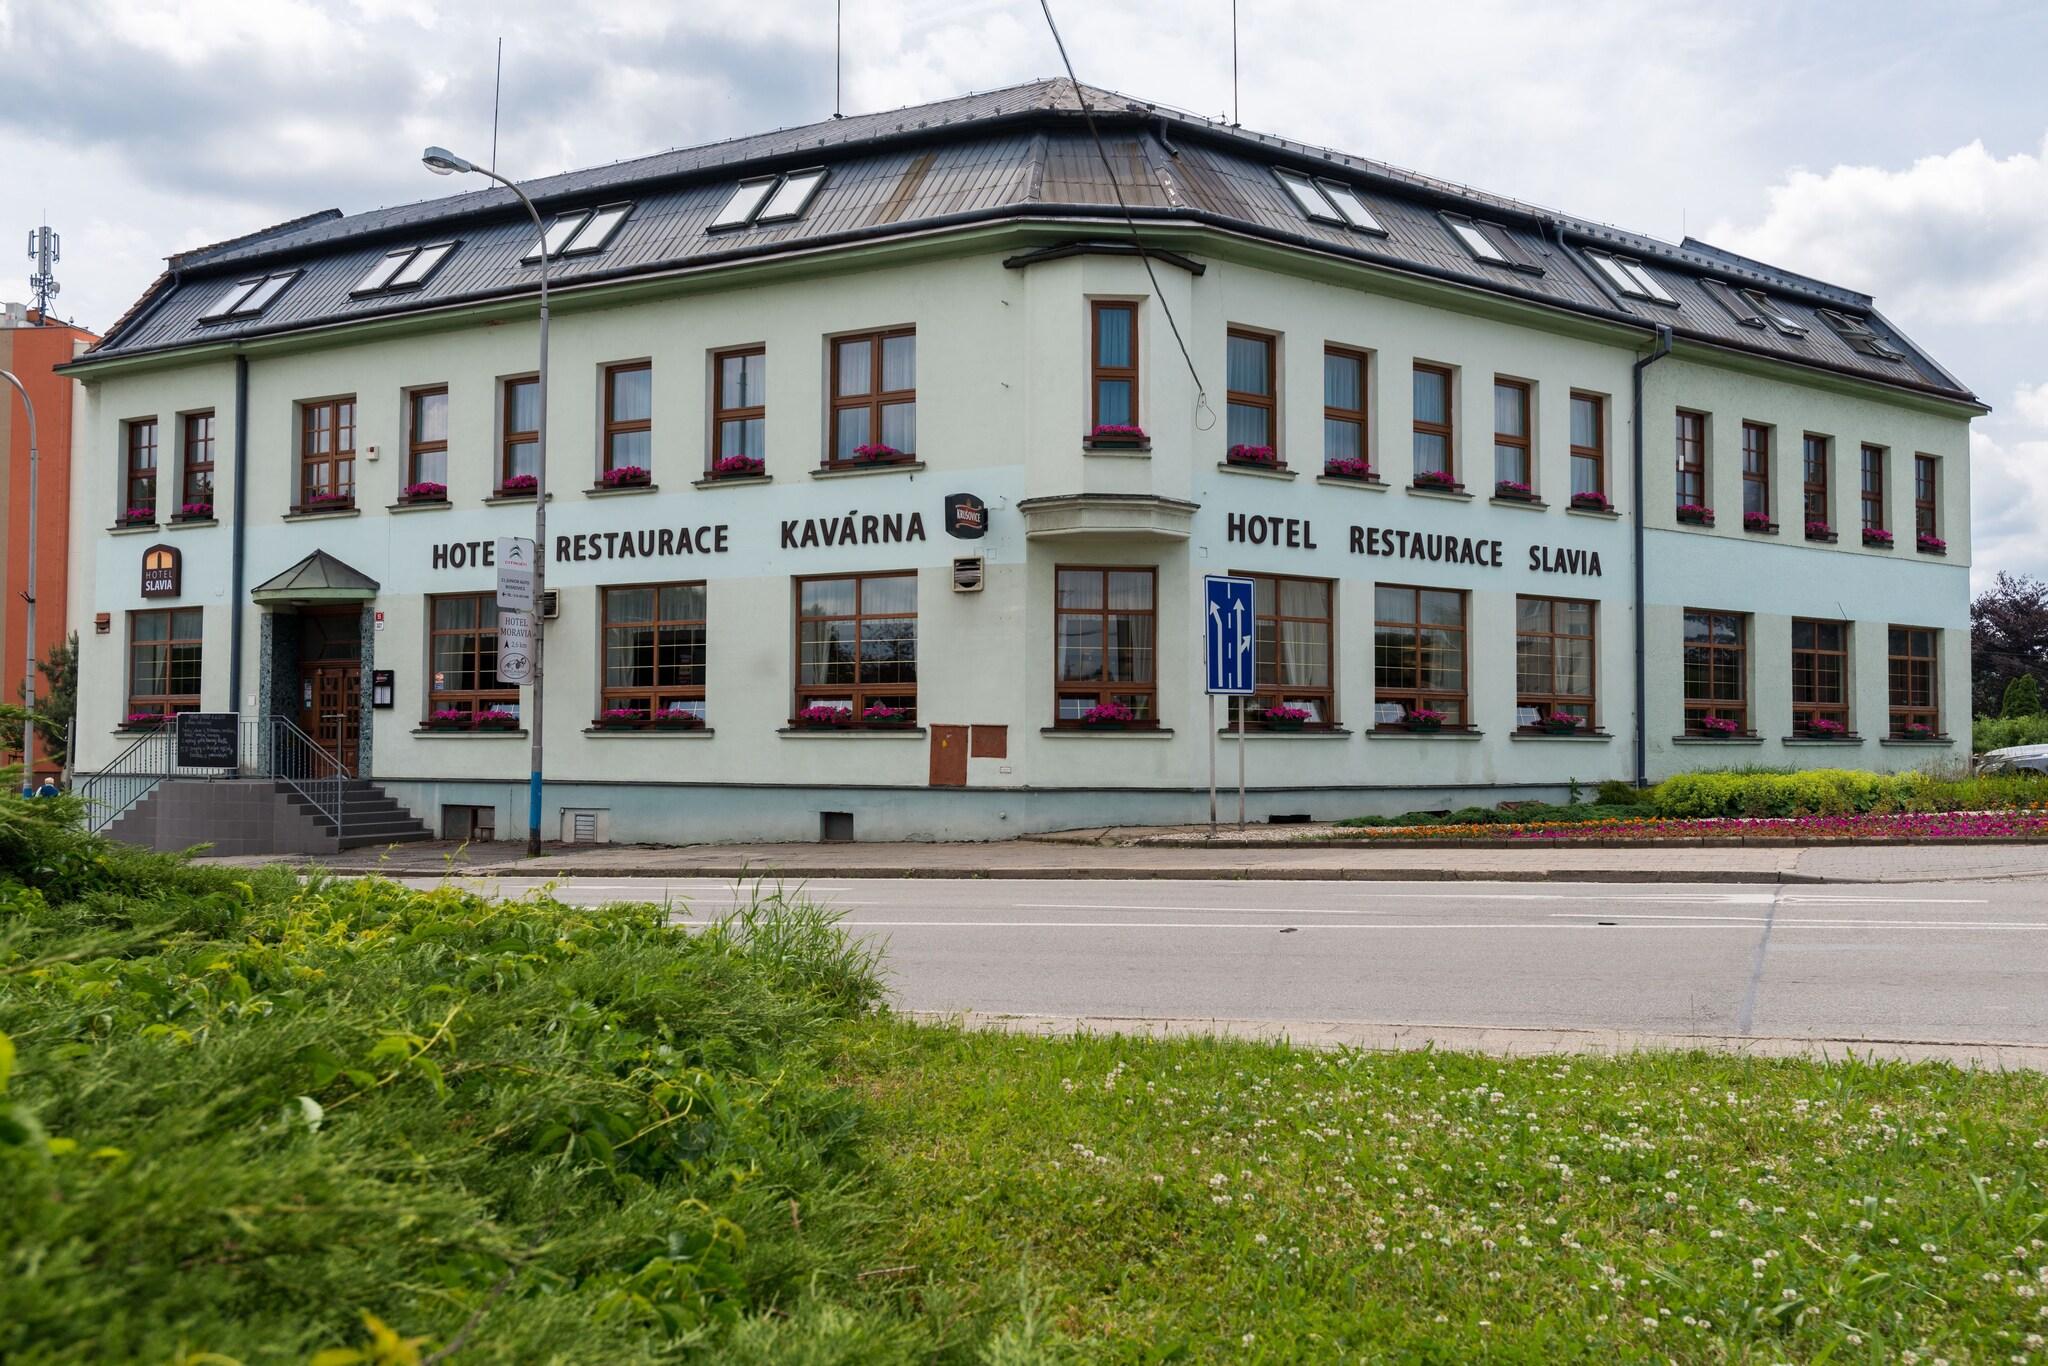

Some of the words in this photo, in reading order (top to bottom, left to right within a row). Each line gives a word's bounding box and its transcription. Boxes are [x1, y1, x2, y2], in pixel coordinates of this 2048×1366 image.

[432, 540, 495, 569] HOTE
[556, 524, 729, 563] RESTAURACE
[780, 509, 927, 549] KAVÁRNA
[1227, 512, 1318, 550] HOTEL
[1349, 525, 1503, 568] RESTAURACE
[1528, 544, 1602, 578] SLAVIA
[145, 570, 173, 580] HOTEL
[145, 579, 173, 592] SLAVIA
[505, 616, 529, 627] HOTEL
[500, 627, 532, 638] MORAVIA
